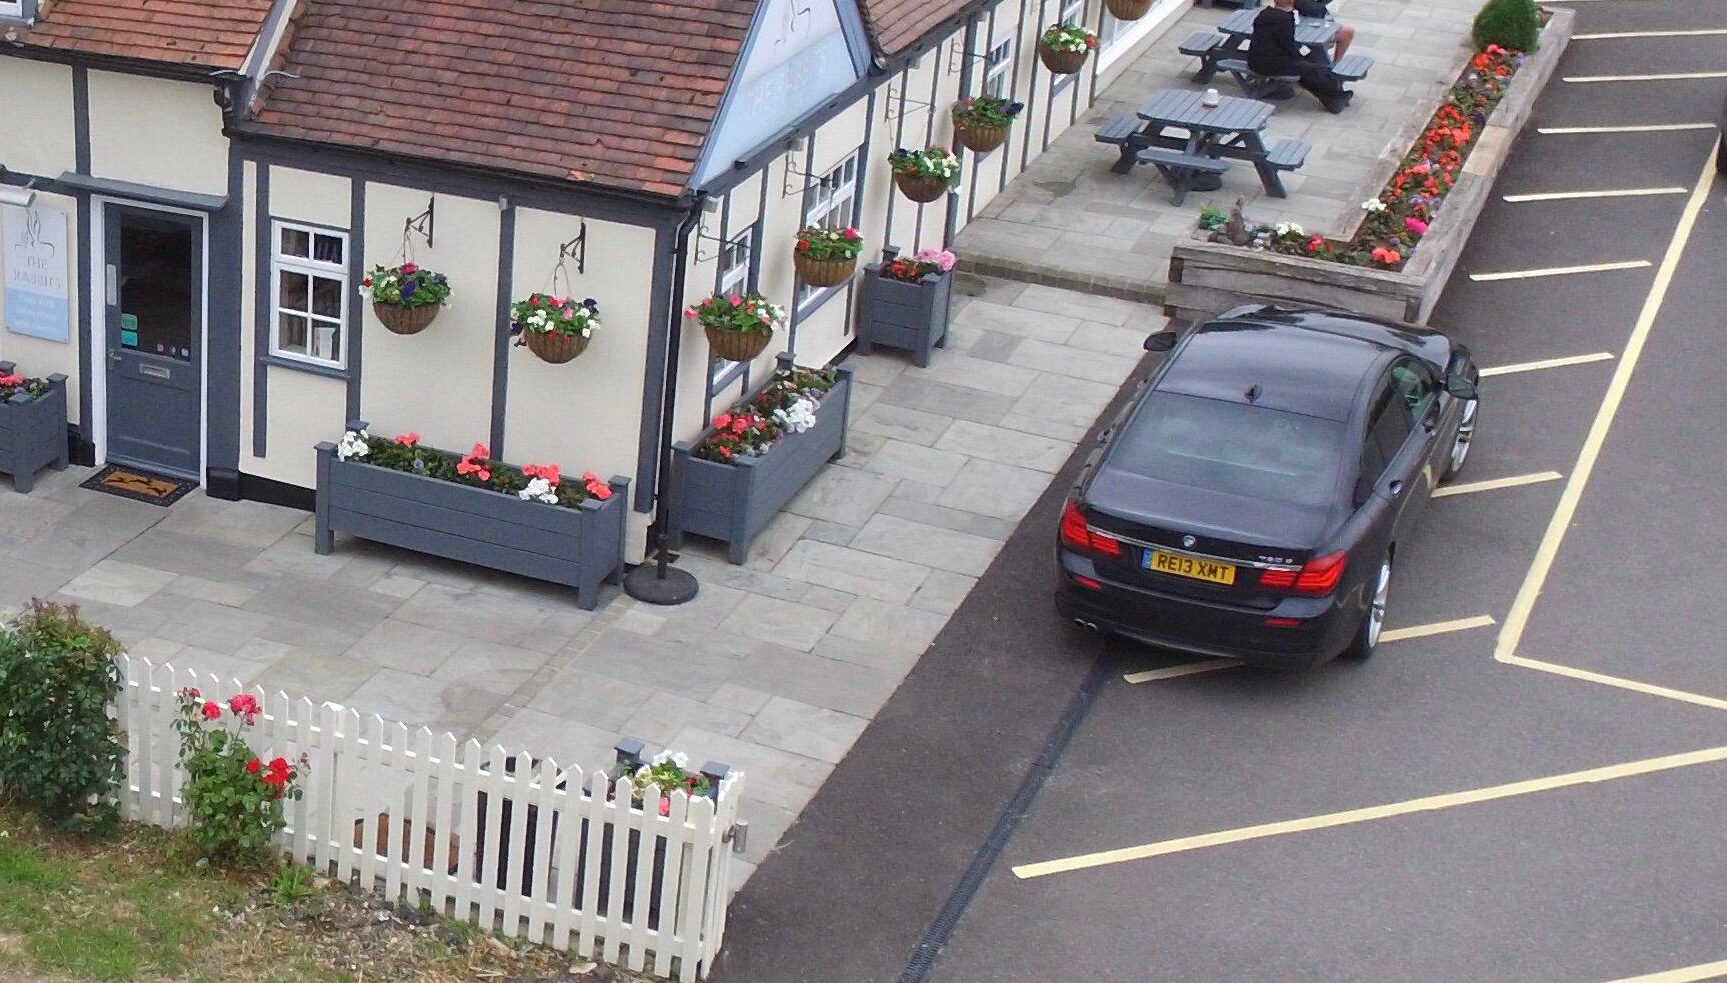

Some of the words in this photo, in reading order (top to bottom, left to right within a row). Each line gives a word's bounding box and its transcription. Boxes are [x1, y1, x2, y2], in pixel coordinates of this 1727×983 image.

[27, 256, 48, 270] THE
[1157, 553, 1194, 574] RE13
[1197, 562, 1229, 580] XMT
